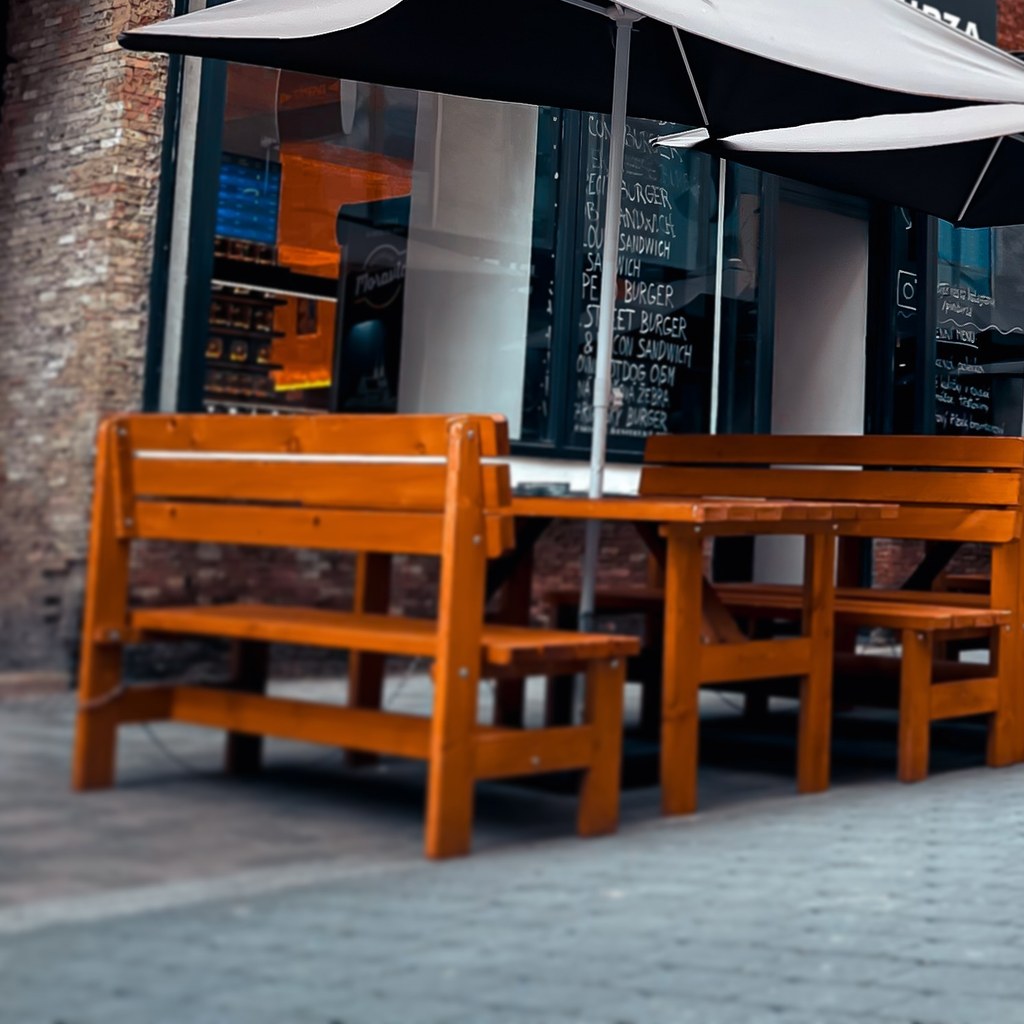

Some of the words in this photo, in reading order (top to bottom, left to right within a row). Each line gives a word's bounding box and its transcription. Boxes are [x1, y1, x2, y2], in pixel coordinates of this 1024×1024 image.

[618, 232, 671, 260] SANDWICH
[623, 278, 675, 309] BURGER
[639, 309, 688, 342] BURGER
[636, 338, 694, 369] SANDWICH
[625, 407, 669, 433] BURGER
